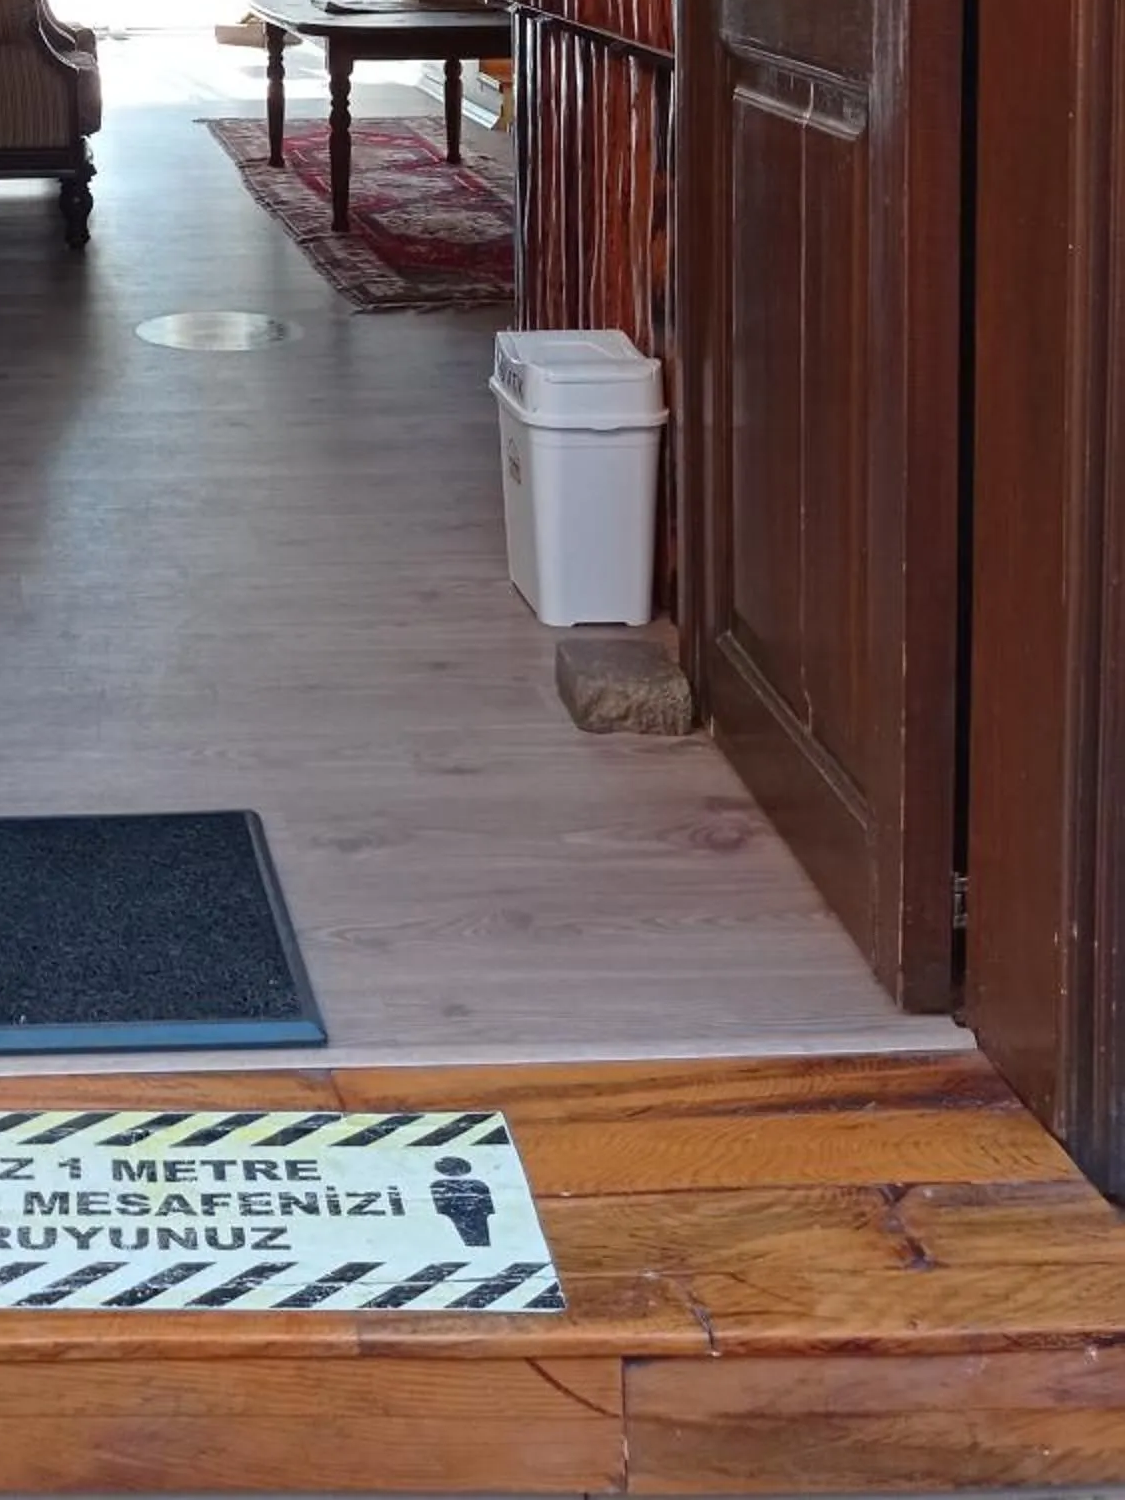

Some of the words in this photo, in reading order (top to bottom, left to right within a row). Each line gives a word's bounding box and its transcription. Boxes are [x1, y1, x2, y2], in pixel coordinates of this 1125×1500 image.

[58, 1157, 82, 1181] 1
[111, 1158, 322, 1183] METRE
[22, 1185, 407, 1217] MESAFENİZİ
